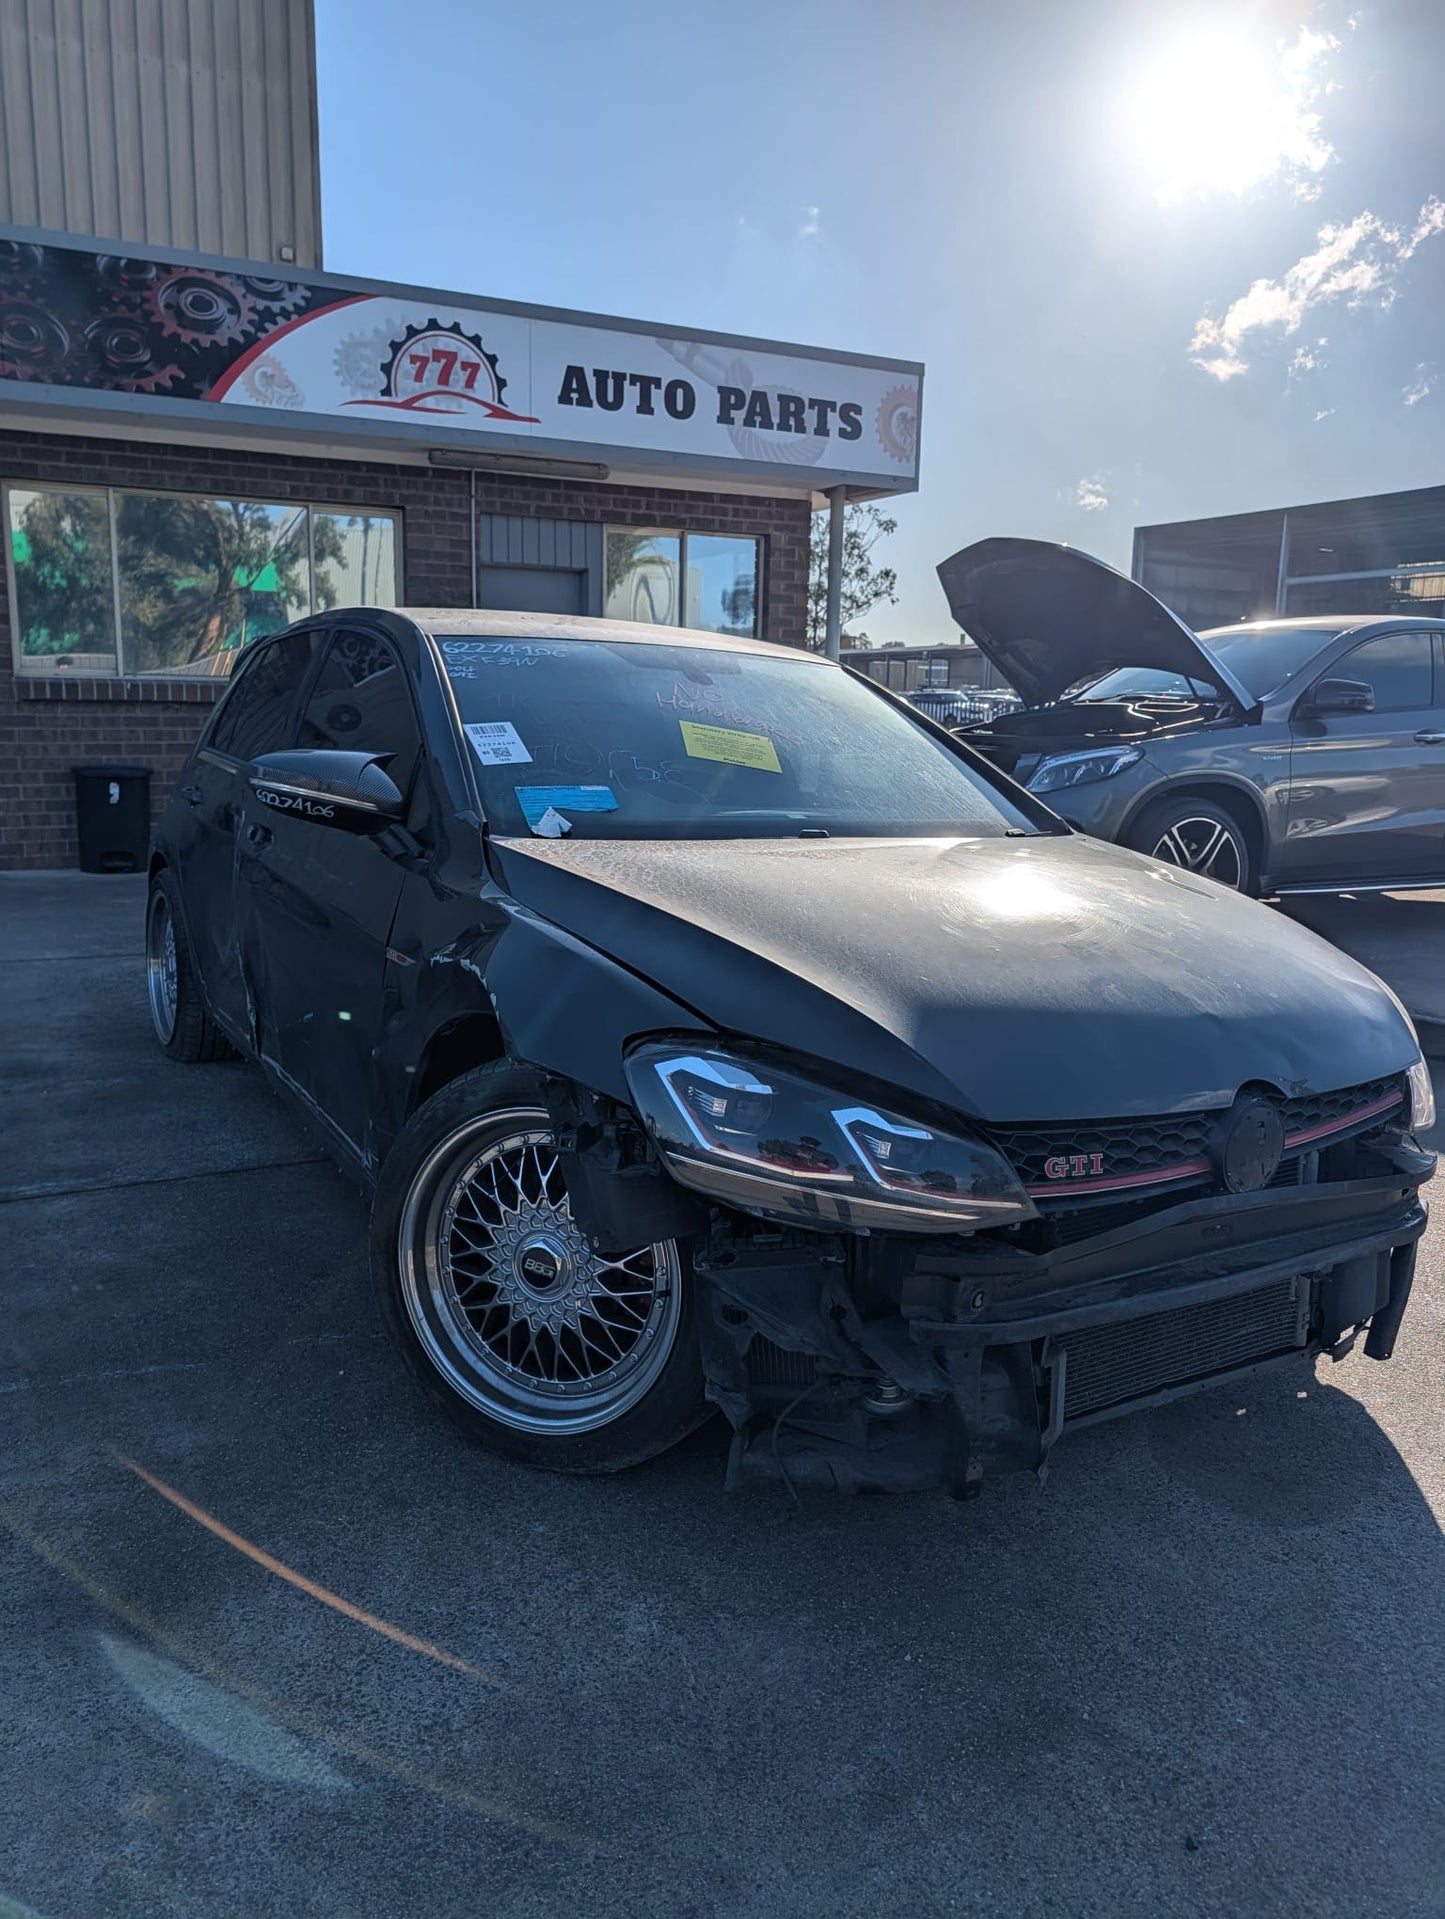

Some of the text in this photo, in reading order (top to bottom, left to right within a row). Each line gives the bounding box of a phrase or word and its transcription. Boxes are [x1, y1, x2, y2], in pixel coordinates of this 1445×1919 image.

[408, 348, 482, 391] 777
[557, 364, 864, 442] AUTO PARTS
[1044, 1153, 1104, 1179] GTI
[524, 1258, 556, 1278] BBS
